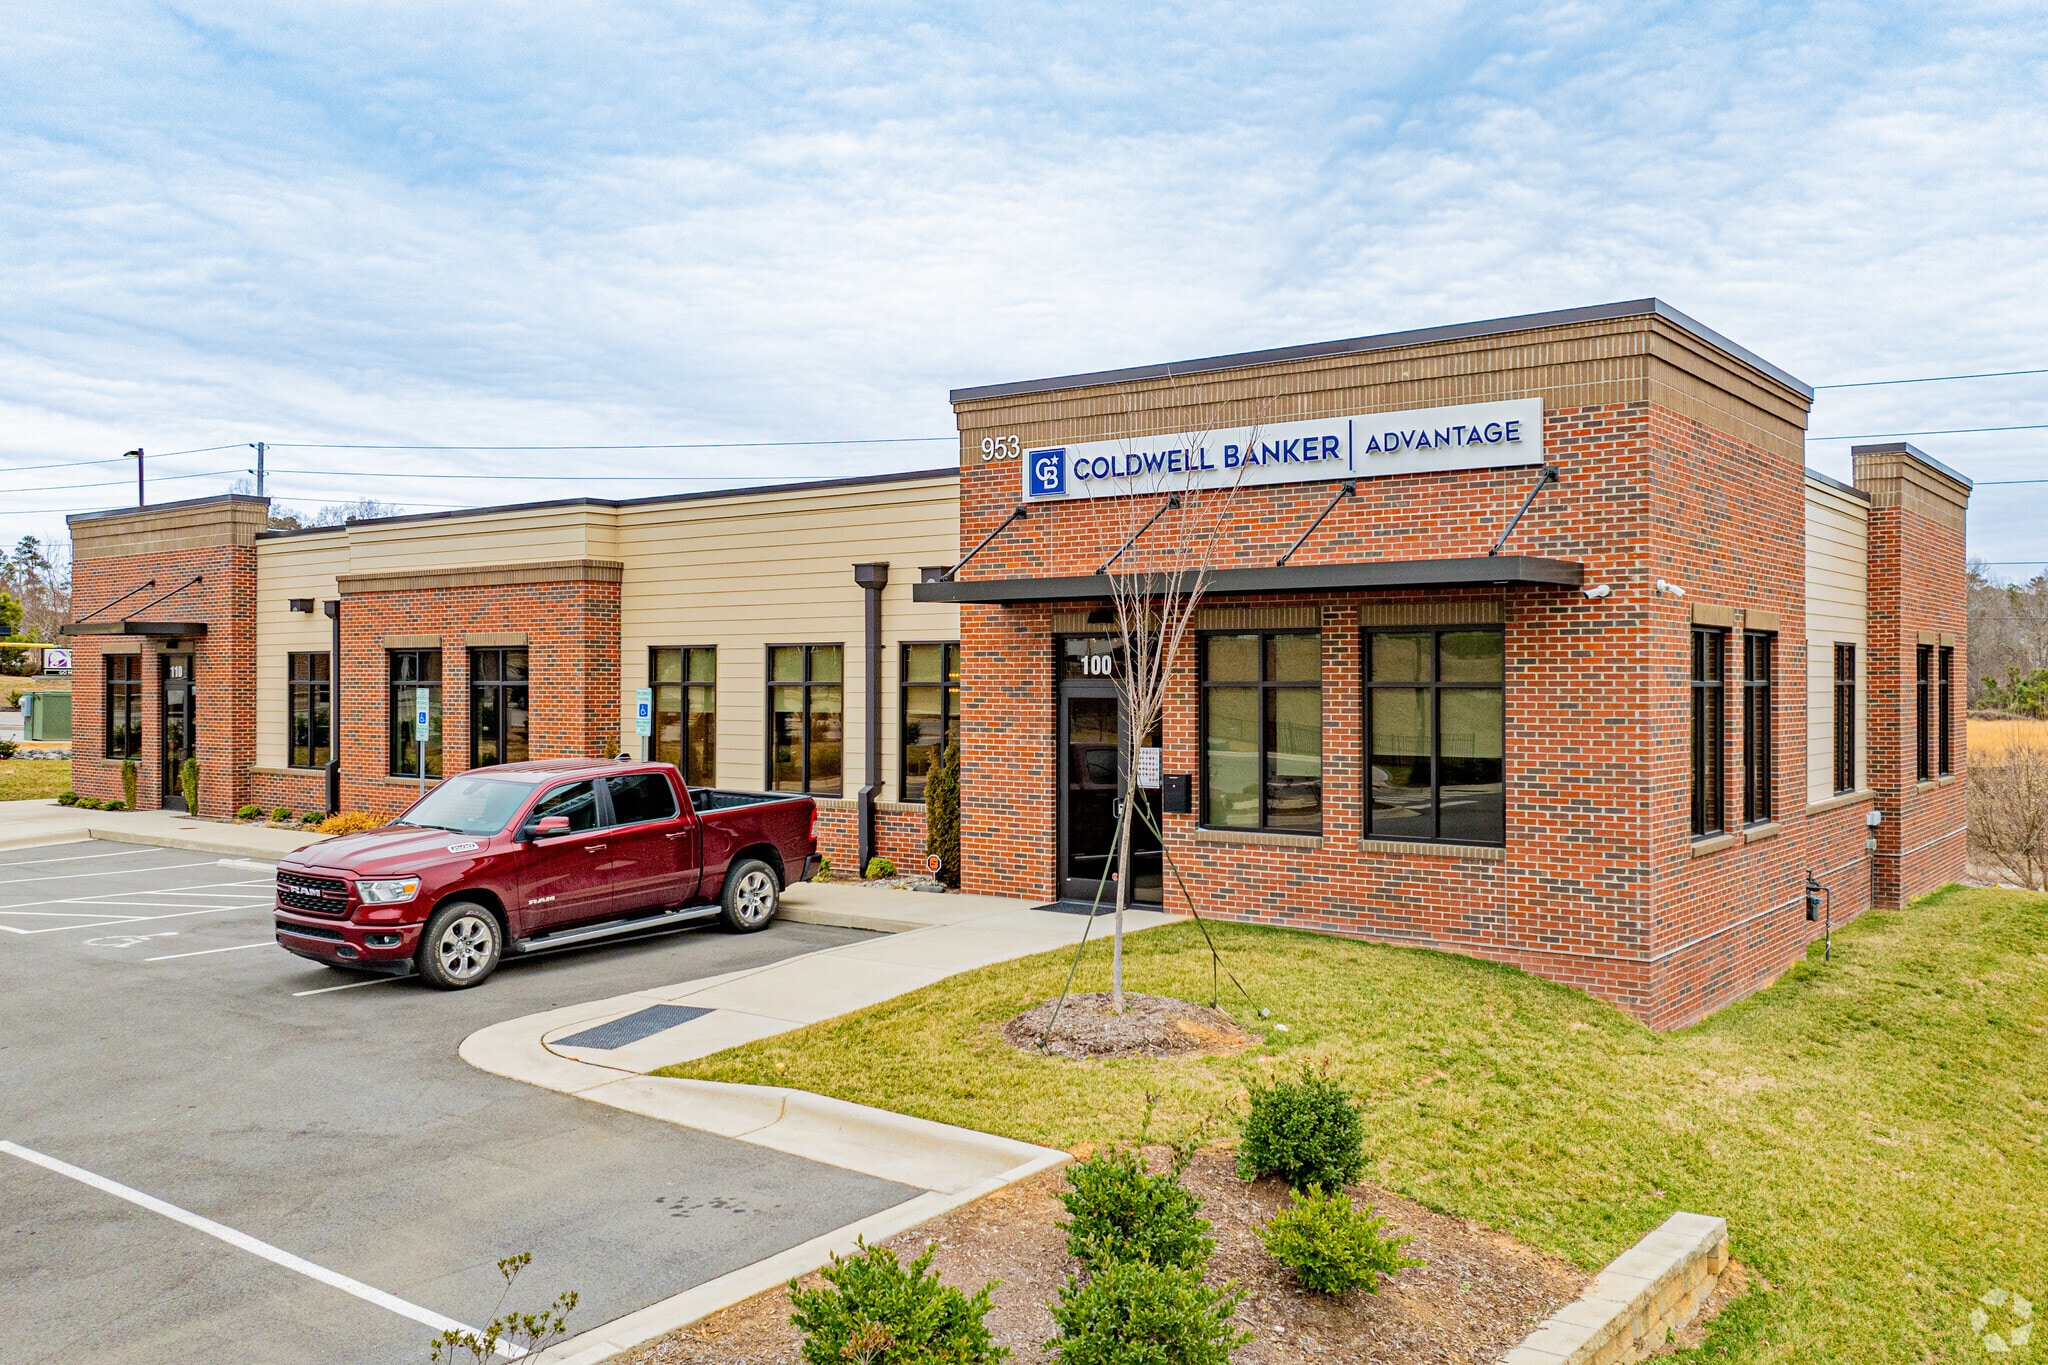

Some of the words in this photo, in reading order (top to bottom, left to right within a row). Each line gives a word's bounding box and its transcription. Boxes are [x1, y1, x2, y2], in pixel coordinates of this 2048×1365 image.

[1365, 420, 1521, 454] ADVANTAGE
[981, 434, 1020, 461] 953
[1073, 447, 1215, 480] COLDWELL
[1224, 435, 1341, 469] BANKER
[169, 665, 183, 678] 110
[1080, 655, 1112, 675] 100
[290, 885, 321, 897] RAM
[528, 895, 556, 905] RAM
